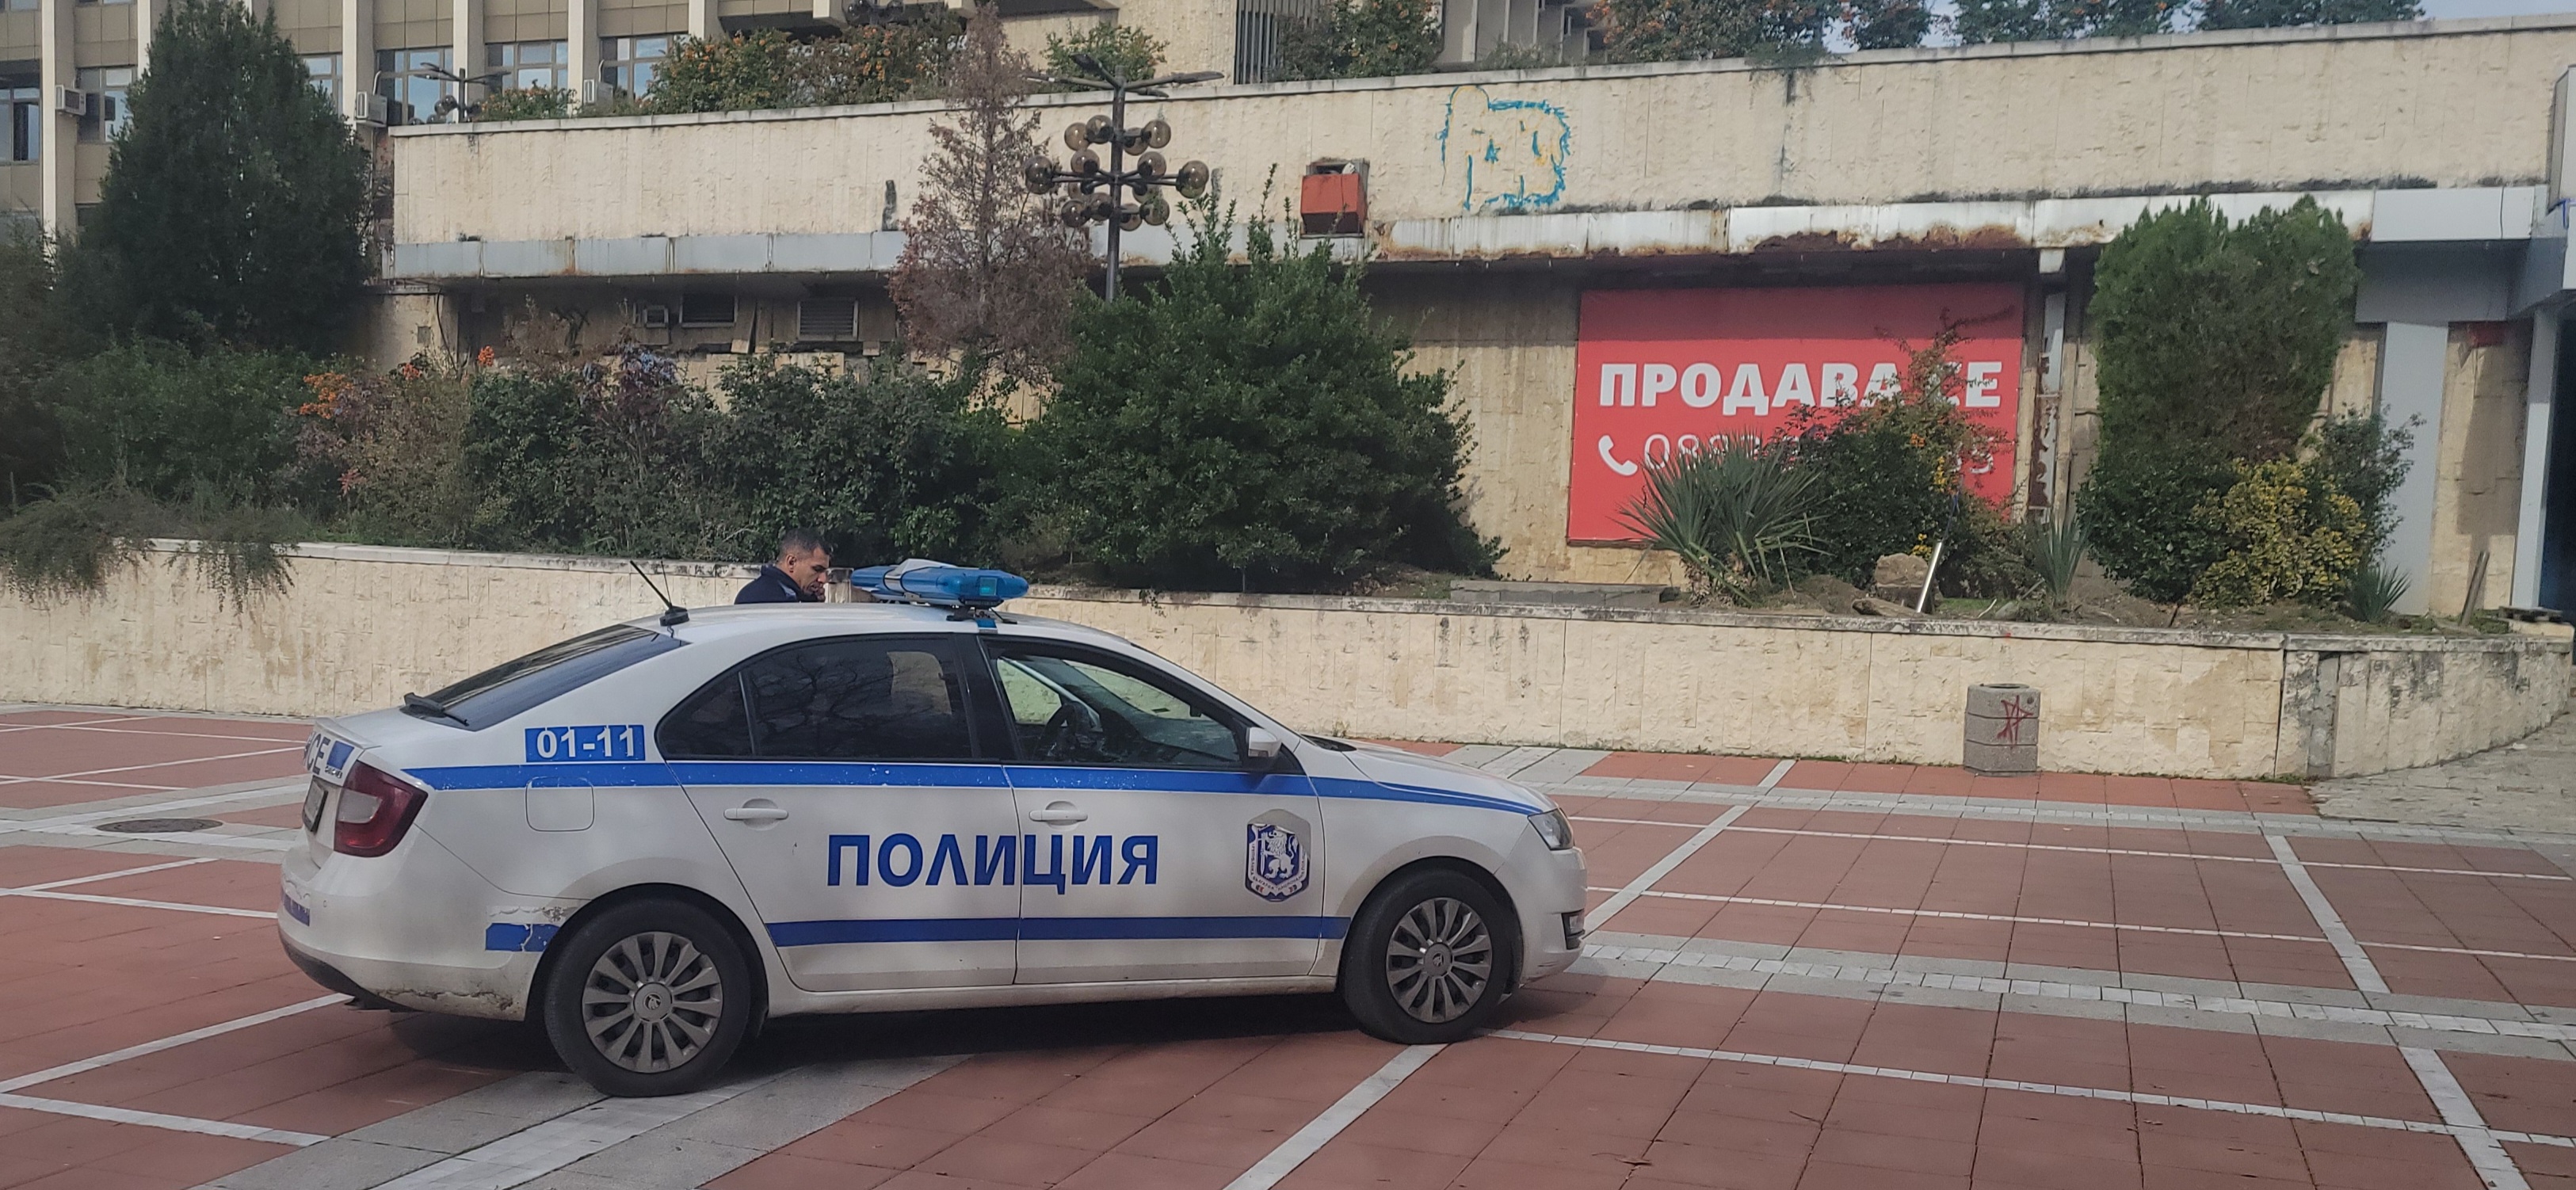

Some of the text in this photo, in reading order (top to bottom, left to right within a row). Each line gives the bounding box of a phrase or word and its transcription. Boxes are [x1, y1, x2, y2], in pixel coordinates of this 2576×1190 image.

[1600, 362, 1905, 416] ПРОДАВА
[536, 727, 634, 758] 01-11
[827, 833, 1158, 894] ПОЛИЦИЯ
